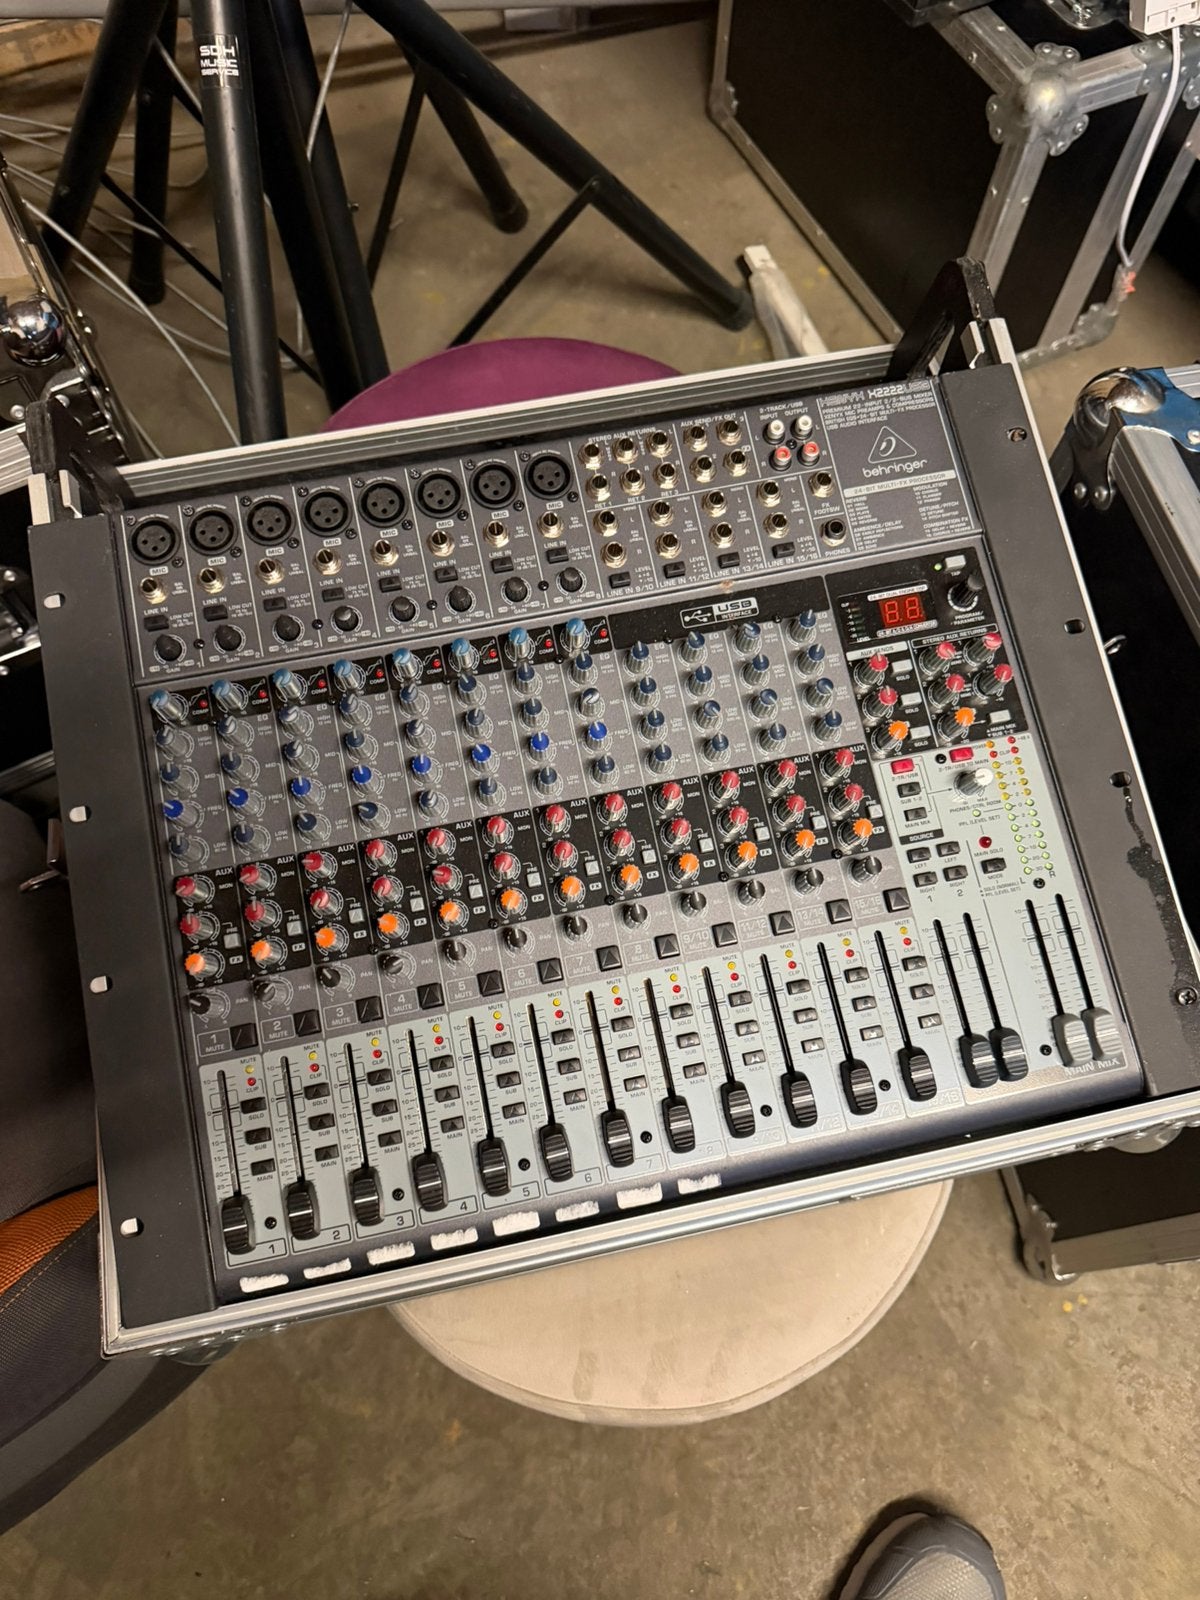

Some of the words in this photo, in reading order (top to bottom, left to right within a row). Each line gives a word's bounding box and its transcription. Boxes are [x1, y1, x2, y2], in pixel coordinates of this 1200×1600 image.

[199, 45, 236, 57] SDH
[200, 58, 238, 68] MUSIC
[724, 412, 737, 420] OUT
[784, 407, 809, 417] OUTPUT
[588, 434, 612, 443] STEREO
[613, 431, 628, 439] AUX
[862, 459, 928, 478] behringer
[824, 547, 851, 557] PHONES
[767, 560, 784, 568] LINE
[713, 569, 730, 578] LINE
[659, 579, 676, 588] LINE
[688, 573, 710, 583] 11/12
[606, 588, 623, 598] LINE
[635, 584, 654, 594] 9/10
[202, 598, 215, 606] LINE
[717, 600, 752, 613] USB
[922, 636, 945, 645] STEREO
[960, 628, 988, 637] RETURNS
[257, 714, 269, 722] EQ
[197, 724, 209, 732] EQ
[975, 758, 989, 766] MAIN
[455, 821, 473, 830] AUX
[905, 820, 919, 829] MAIN
[397, 833, 415, 841] AUX
[909, 833, 934, 842] SOURCE
[338, 844, 355, 853] AUX
[276, 856, 295, 865] AUX
[215, 867, 234, 876] AUX
[1049, 870, 1056, 878] R
[957, 889, 964, 897] 2
[577, 956, 583, 965] 7
[517, 968, 525, 977] 6
[458, 982, 466, 991] 5
[398, 994, 406, 1003] 4
[336, 1007, 344, 1017] 3
[392, 1003, 413, 1013] MUTE
[331, 1017, 351, 1025] MUTE
[210, 1034, 217, 1044] 1
[268, 1030, 288, 1039] MUTE
[205, 1043, 225, 1053] MUTE
[1064, 1063, 1094, 1076] MAIN
[1099, 1058, 1121, 1069] MIX
[320, 1160, 337, 1168] MAIN
[585, 1173, 592, 1182] 6
[522, 1187, 530, 1196] 5
[459, 1201, 468, 1211] 4
[396, 1216, 405, 1226] 3
[332, 1230, 341, 1240] 2
[268, 1244, 276, 1254] 1
